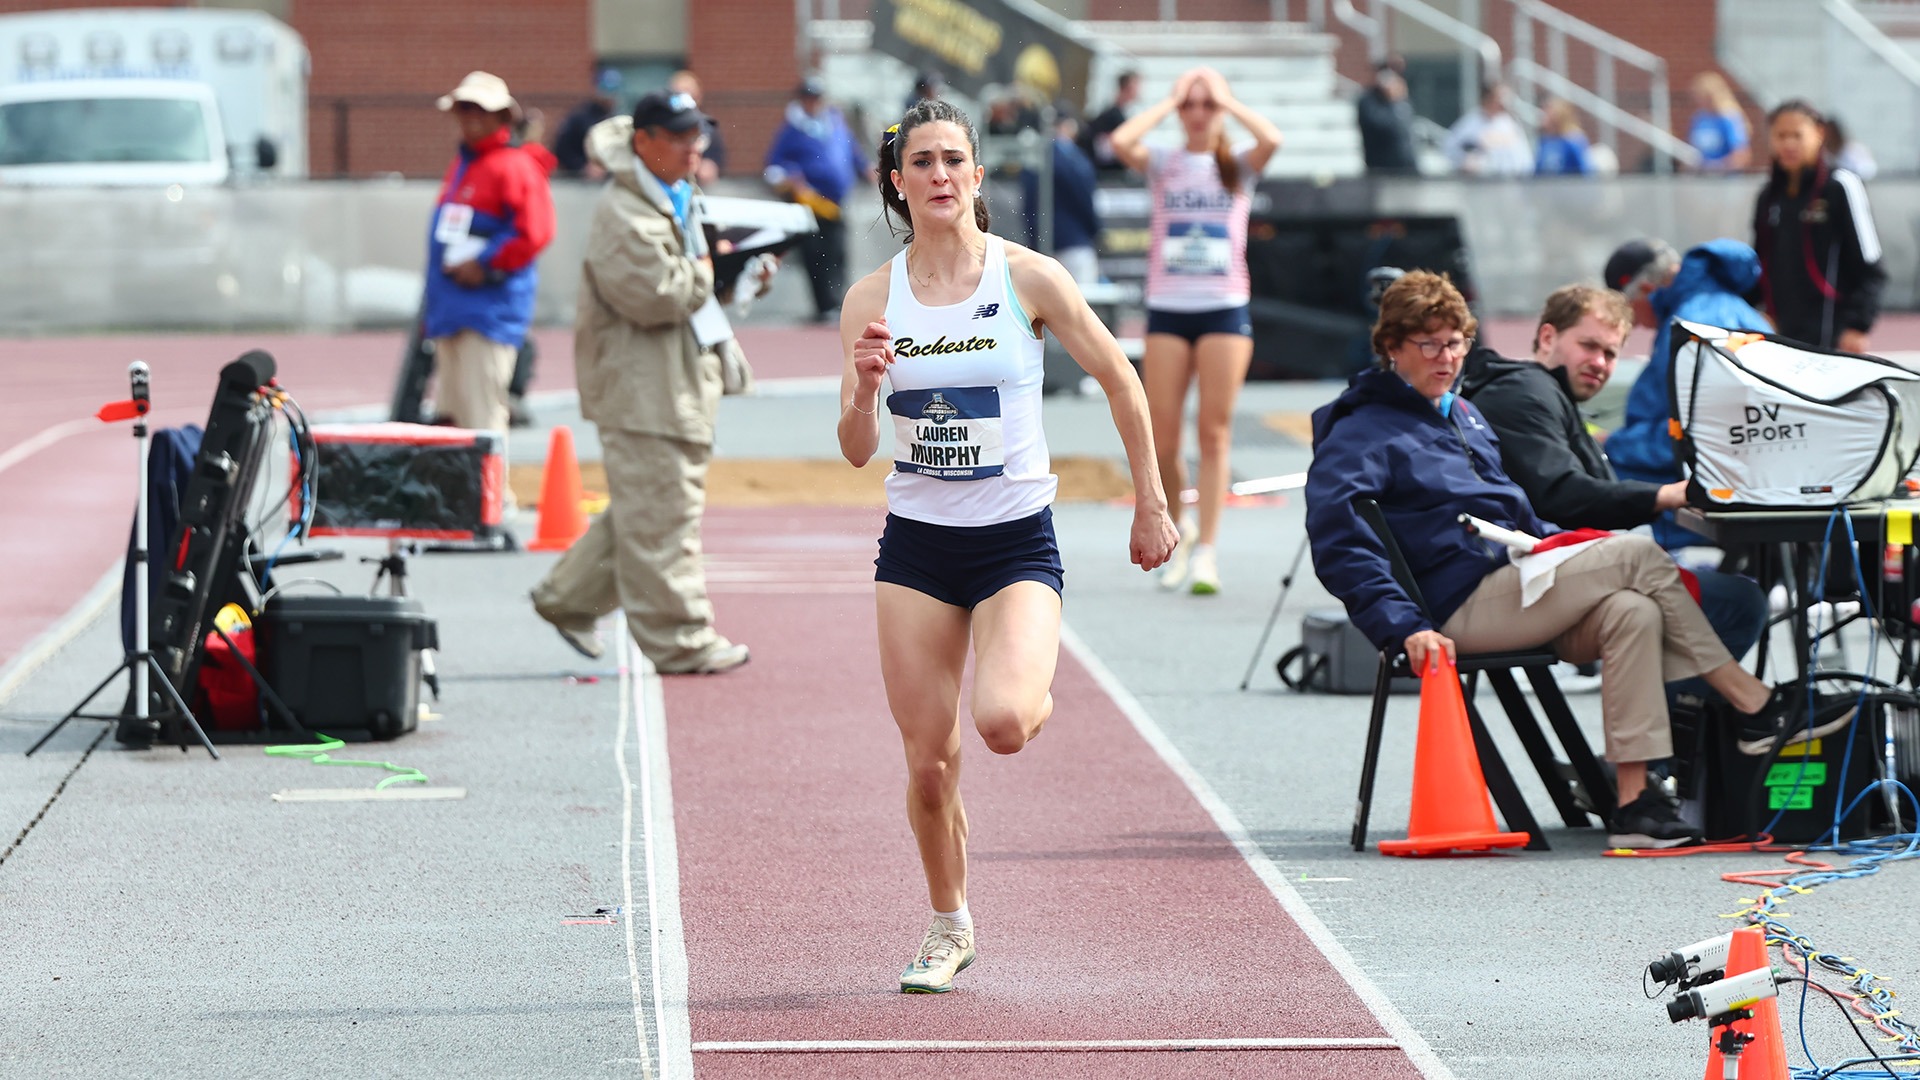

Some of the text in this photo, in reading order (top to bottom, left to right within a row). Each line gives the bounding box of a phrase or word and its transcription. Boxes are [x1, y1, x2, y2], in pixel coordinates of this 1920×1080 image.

[894, 335, 997, 358] Rochester
[1744, 403, 1781, 425] DV
[916, 425, 968, 442] LAUREN
[910, 443, 981, 466] MURPHY
